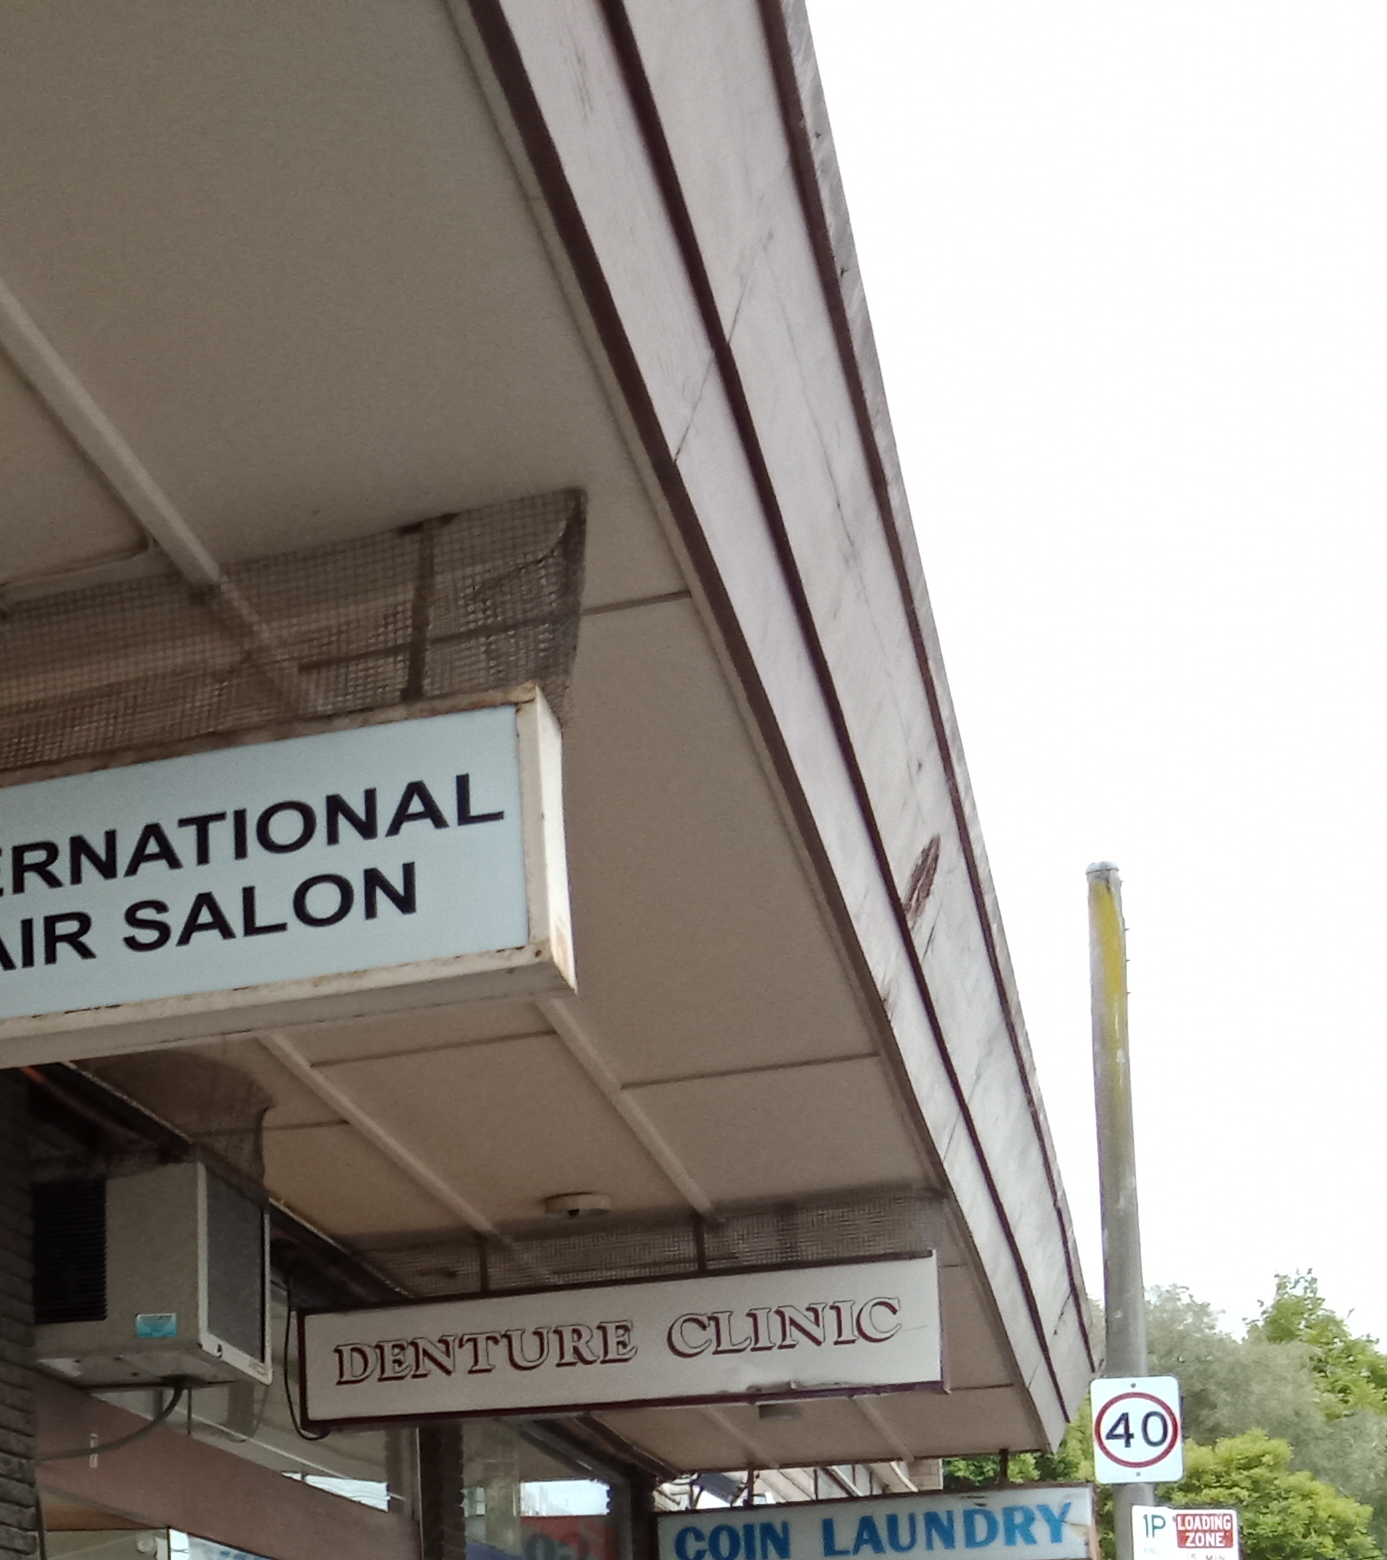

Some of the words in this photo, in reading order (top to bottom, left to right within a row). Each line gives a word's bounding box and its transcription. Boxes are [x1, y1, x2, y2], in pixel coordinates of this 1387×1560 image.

[122, 862, 417, 953] SALON
[332, 1319, 638, 1385] DENTURE
[666, 1297, 902, 1359] CLINIC
[1105, 1411, 1168, 1448] 40
[821, 1502, 1072, 1558] LAUNDRY
[1143, 1514, 1166, 1538] 1P
[1177, 1515, 1231, 1531] LOADING
[1185, 1532, 1226, 1547] ZONE
